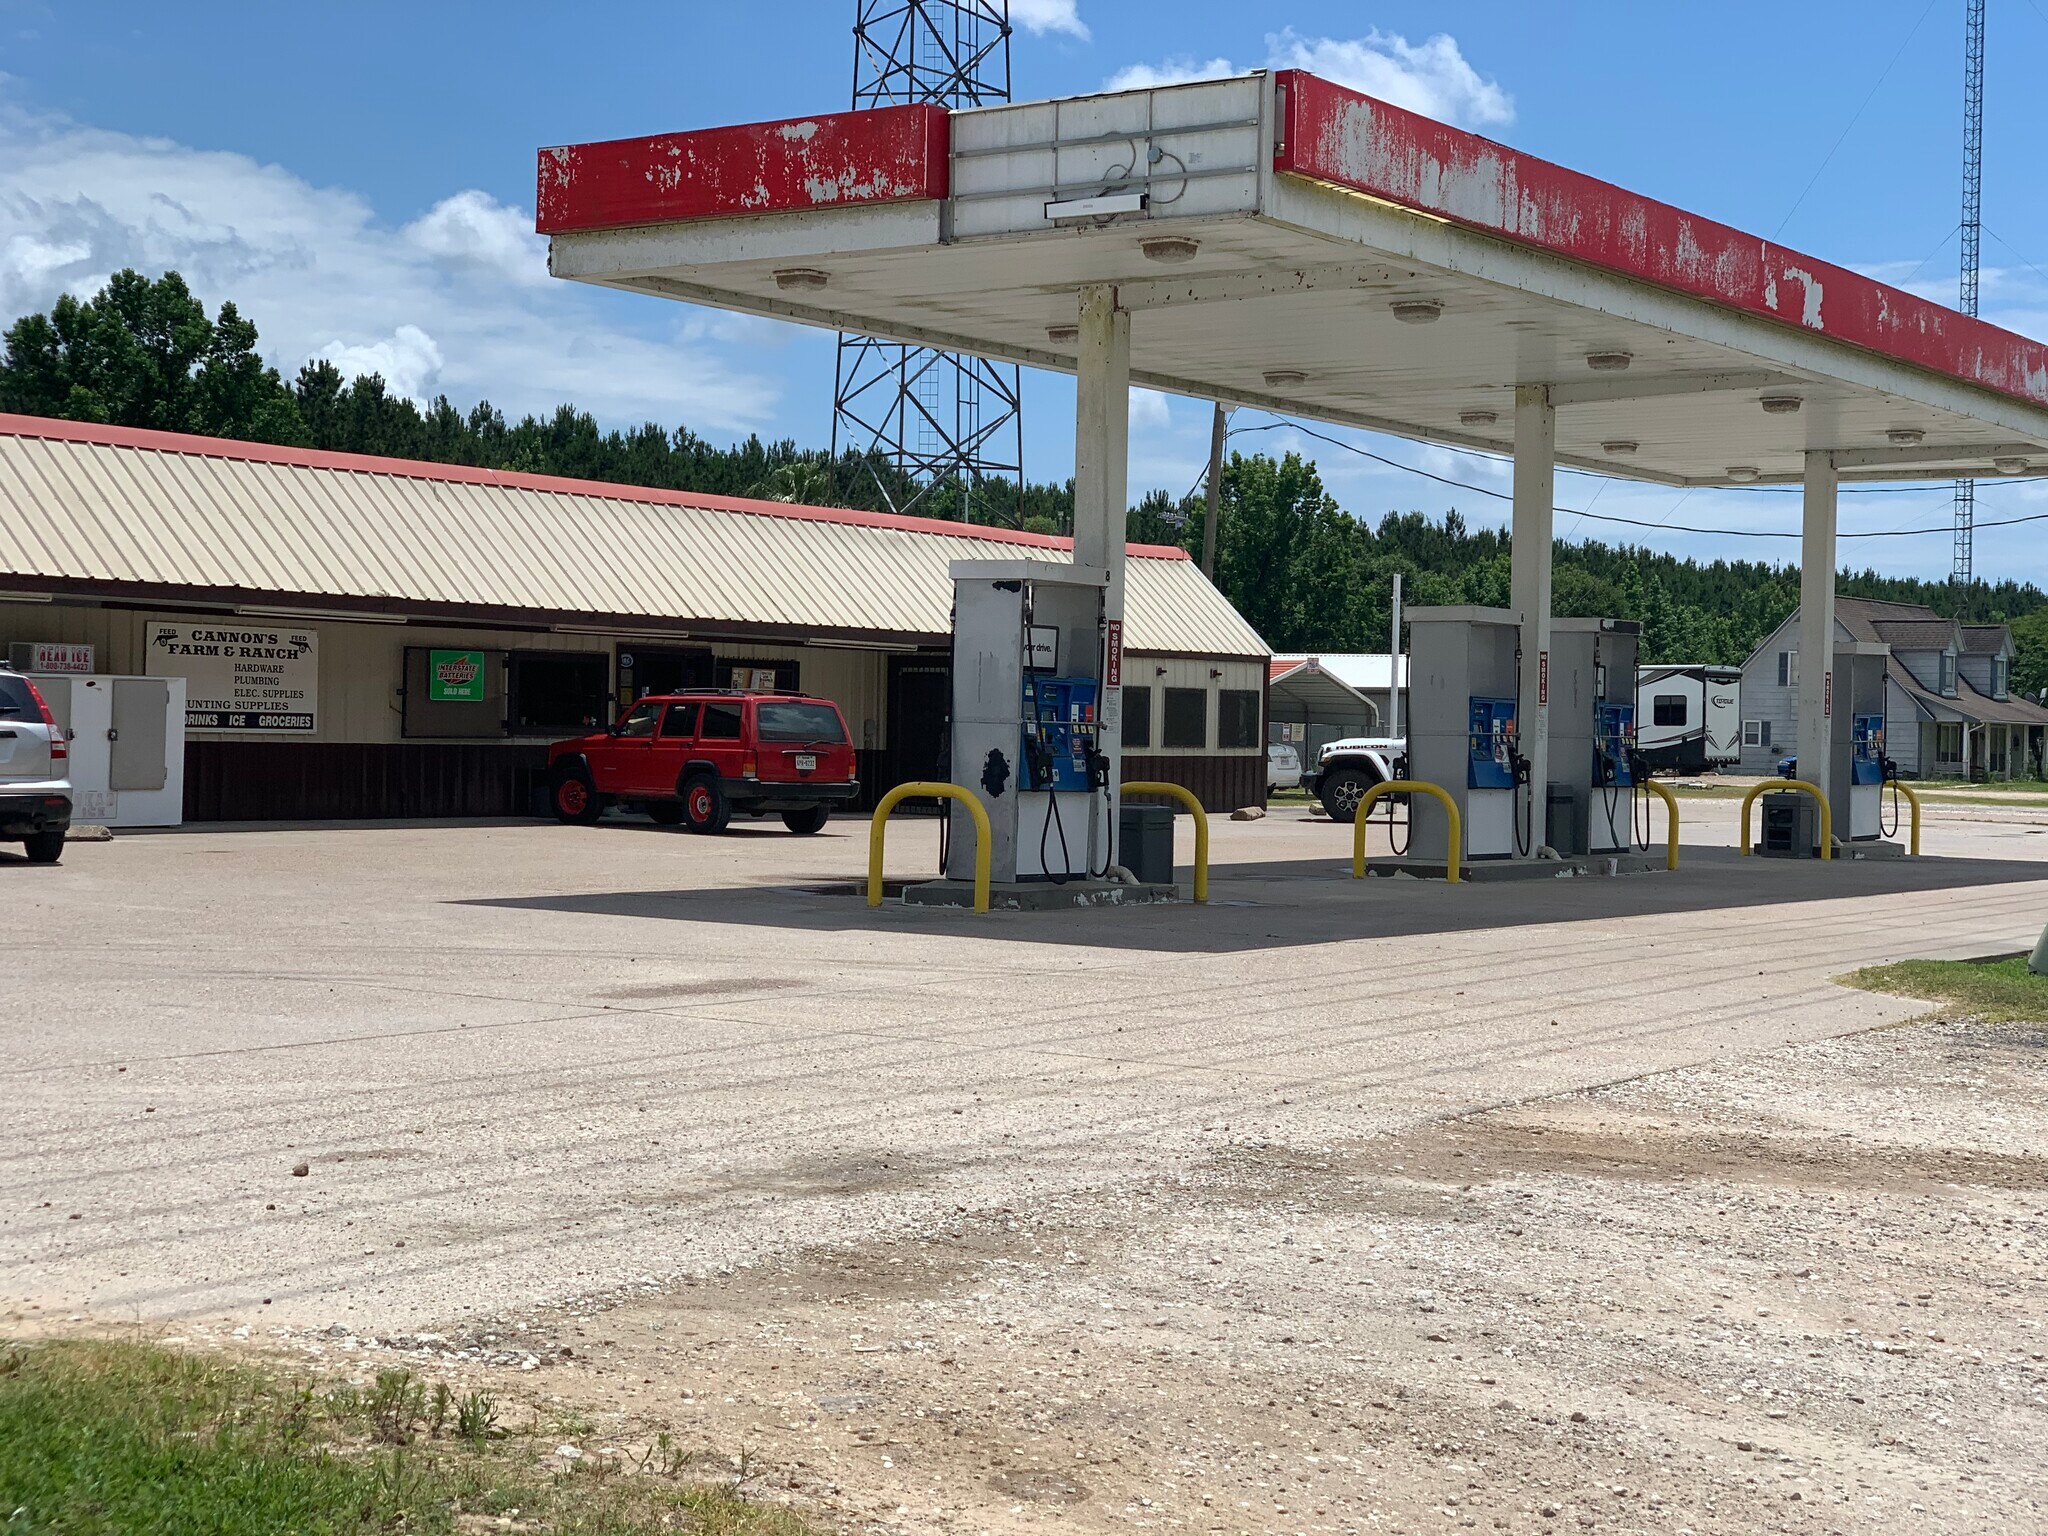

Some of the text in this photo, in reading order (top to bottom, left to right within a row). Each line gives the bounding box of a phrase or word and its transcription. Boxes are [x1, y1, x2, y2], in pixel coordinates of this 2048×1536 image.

[1105, 570, 1111, 581] 8
[1110, 623, 1120, 631] NO
[191, 630, 278, 645] CANNON'S
[167, 643, 300, 660] FARM & RANCH
[1110, 633, 1119, 683] SMOKING
[234, 663, 285, 674] HARDWARE
[437, 664, 477, 672] INTERSTATE
[439, 671, 475, 679] BATTERIES
[234, 676, 280, 686] PLUMBING
[234, 689, 304, 699] ELEC. SUPPLIES
[185, 700, 289, 711] UNTING SUPPLIES
[228, 714, 246, 726] ICE
[258, 715, 311, 728] GROCERIES
